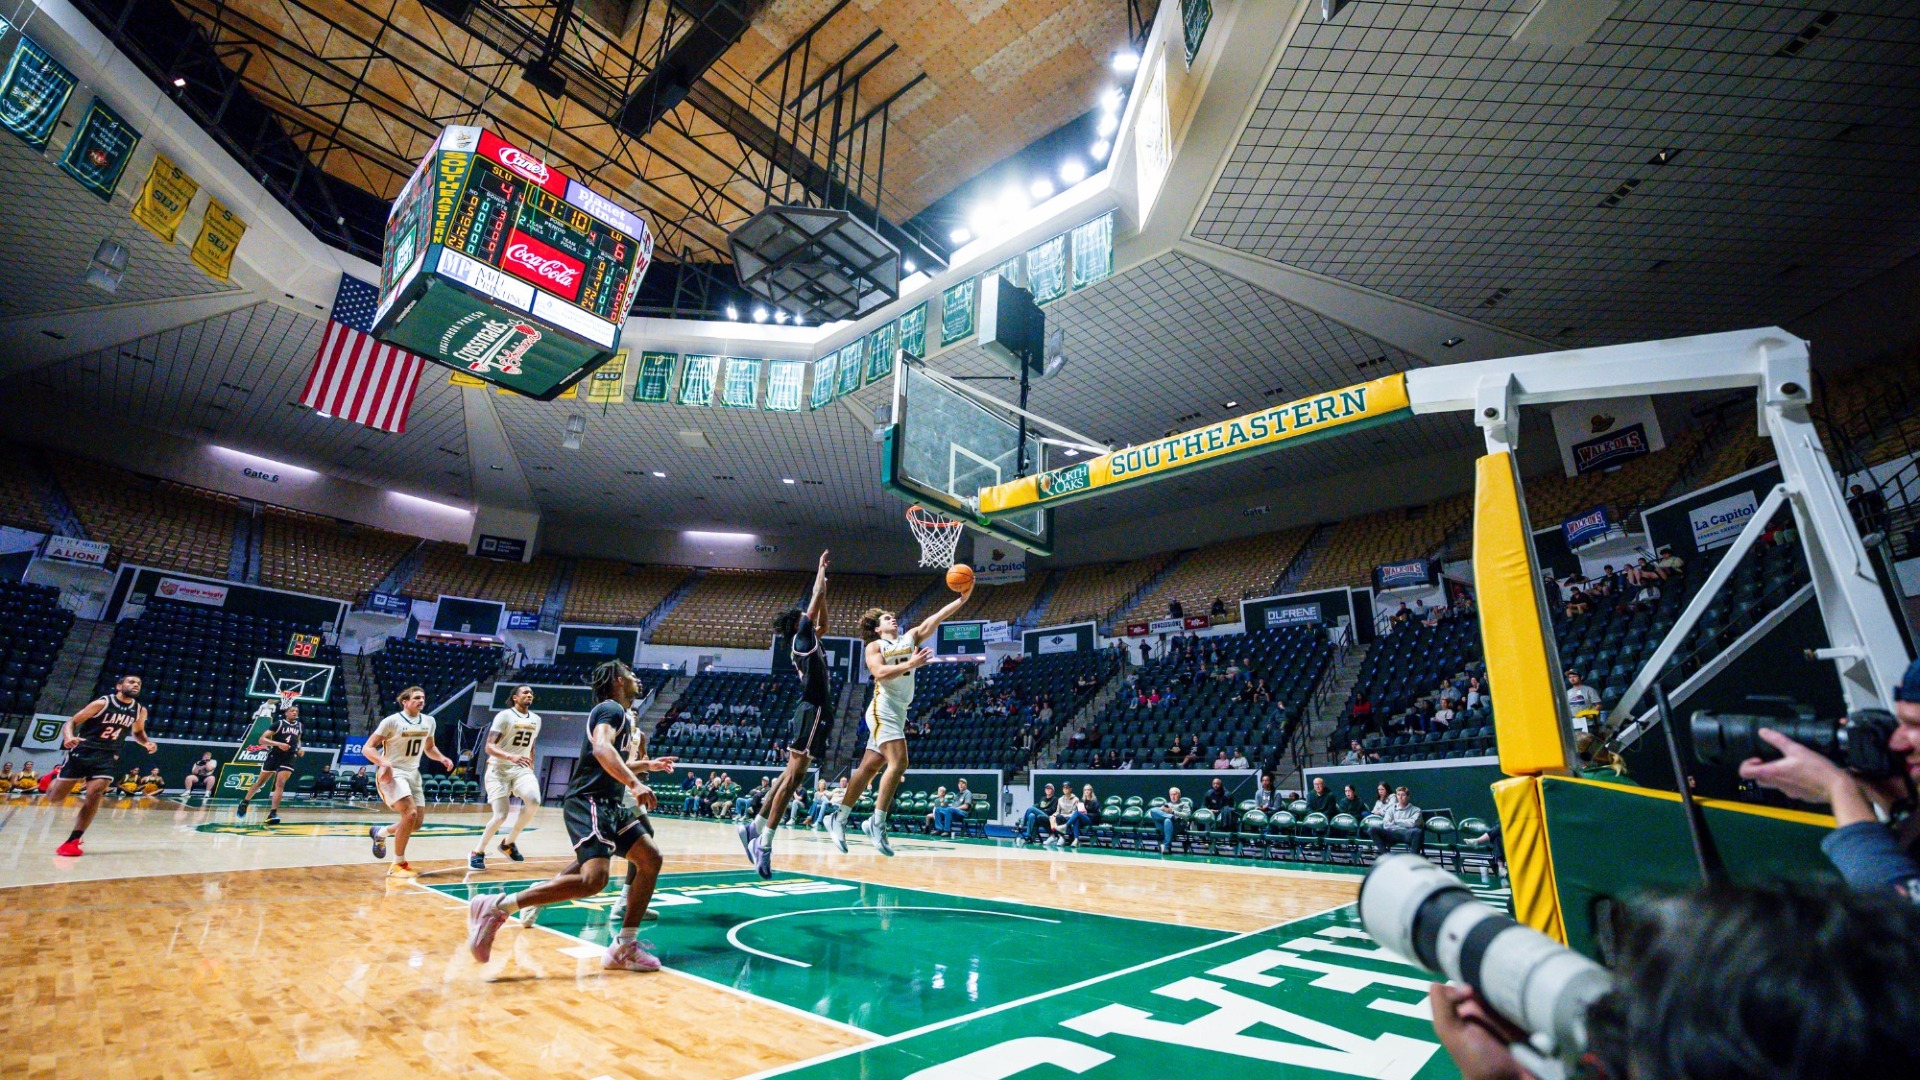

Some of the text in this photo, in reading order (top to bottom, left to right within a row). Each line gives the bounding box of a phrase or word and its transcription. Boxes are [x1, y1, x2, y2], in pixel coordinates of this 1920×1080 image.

[492, 166, 512, 181] SLU
[433, 152, 468, 243] SOUTHEASTERN
[501, 182, 512, 202] 4
[471, 196, 506, 220] 0 0 3
[578, 189, 626, 219] planet
[468, 207, 502, 230] 5 0 0
[519, 215, 526, 225] 2
[583, 200, 633, 235] fitness
[460, 216, 499, 241] 10 0 0
[449, 236, 463, 250] 23
[467, 244, 474, 254] 0
[456, 227, 495, 251] 12 0 0
[561, 241, 576, 252] FOULS
[563, 237, 576, 246] TEAM
[585, 249, 591, 258] 3
[614, 243, 624, 260] 6
[599, 261, 606, 270] 0
[596, 272, 625, 291] 3 0 0
[584, 288, 619, 311] 22 0 5
[593, 282, 600, 291] 4
[616, 293, 622, 301] 0
[581, 299, 594, 310] 24
[611, 312, 616, 320] 0
[453, 320, 508, 361] Crossroads
[1111, 388, 1367, 476] SOUTHEASTERN
[244, 468, 269, 479] Gate
[1051, 466, 1088, 487] NORTH
[1055, 477, 1085, 494] OAKS
[1694, 519, 1708, 531] La
[1710, 504, 1756, 526] Capitol
[53, 548, 100, 561] A LION!
[974, 562, 1026, 574] La Capitol
[1267, 606, 1317, 620] DUFRENE
[292, 643, 312, 657] 28
[39, 724, 55, 737] S
[100, 726, 123, 741] 24
[285, 735, 292, 743] 4
[512, 731, 533, 747] 23
[344, 744, 364, 753] FG
[405, 740, 422, 756] 10
